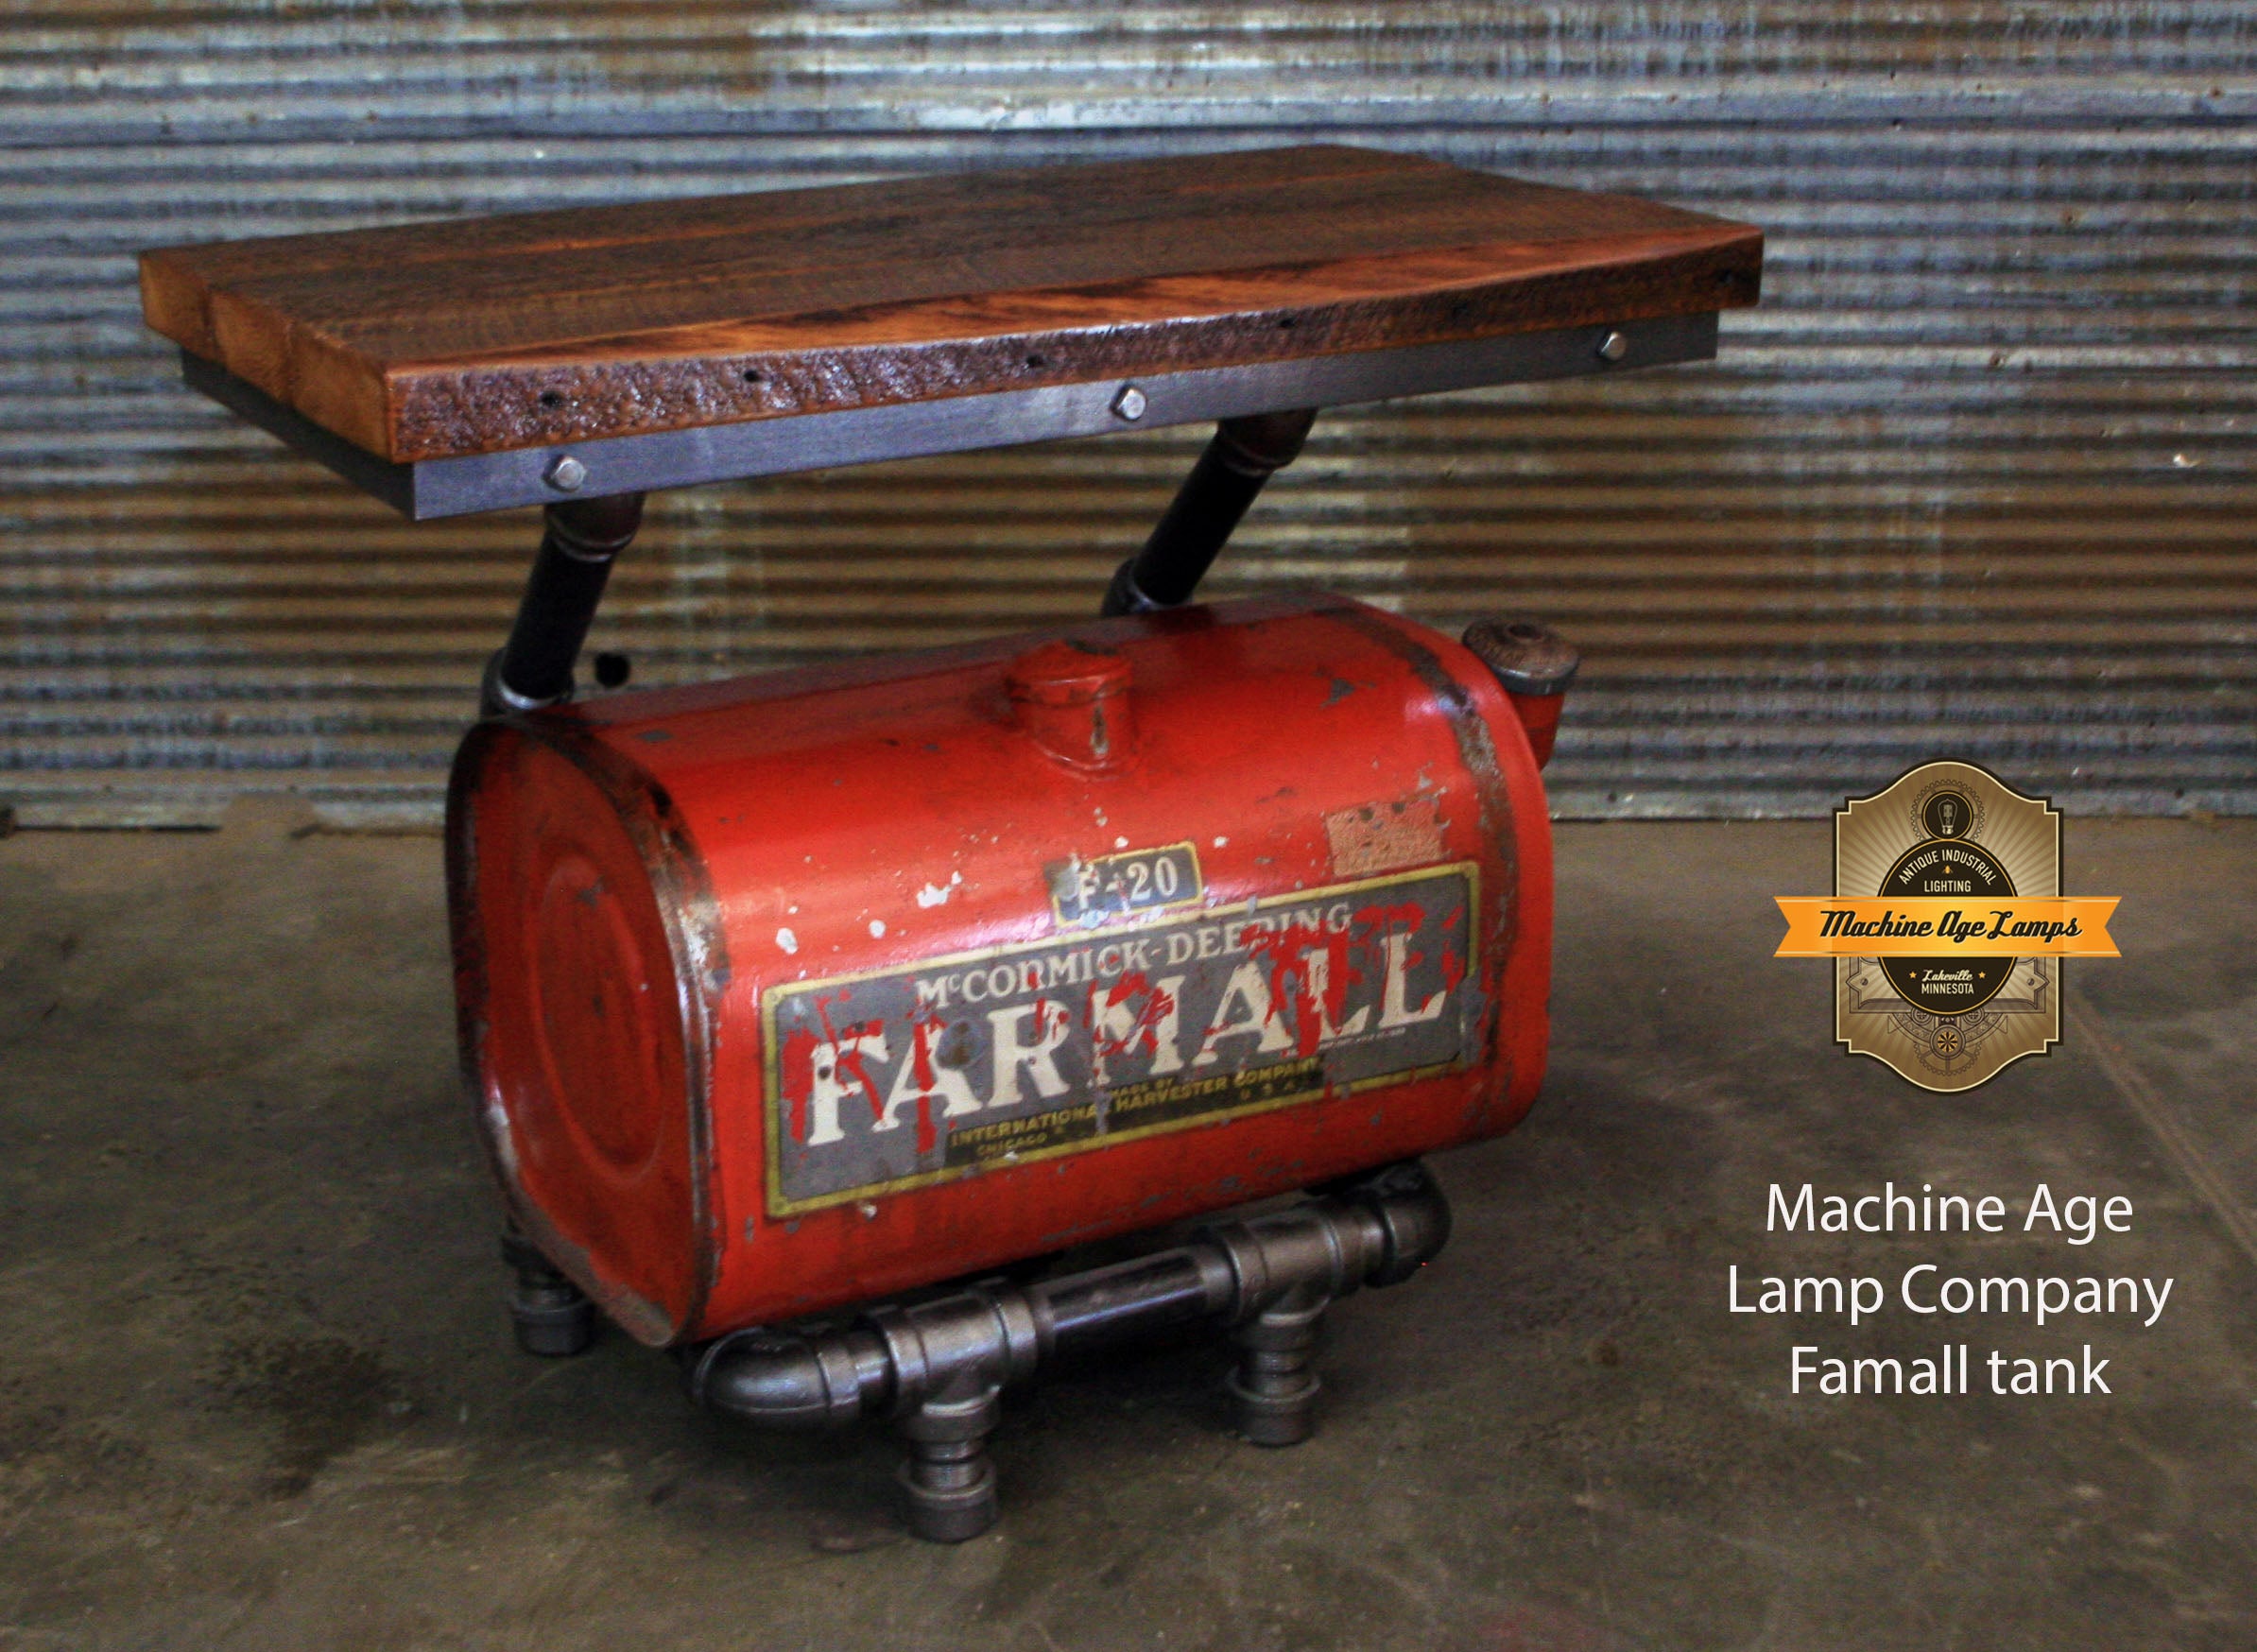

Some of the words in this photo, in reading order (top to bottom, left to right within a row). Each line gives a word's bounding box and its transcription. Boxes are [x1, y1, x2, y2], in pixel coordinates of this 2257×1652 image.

[808, 933, 1447, 1147] FARMALL
[1115, 1076, 1228, 1113] HARVESTER
[1232, 1057, 1320, 1087] COMPANY
